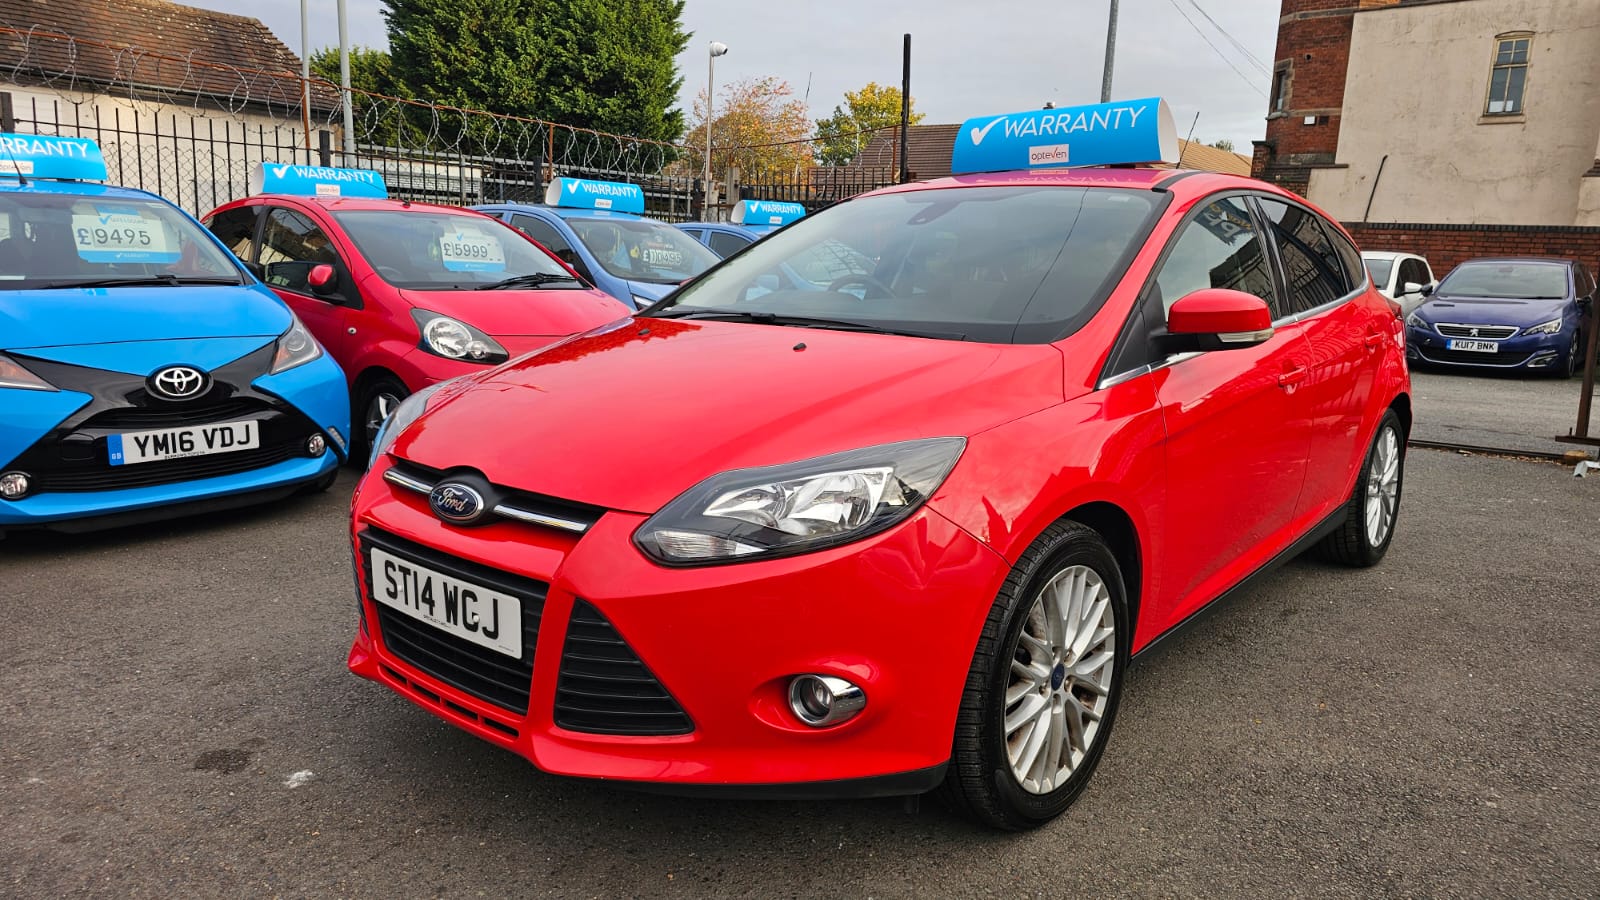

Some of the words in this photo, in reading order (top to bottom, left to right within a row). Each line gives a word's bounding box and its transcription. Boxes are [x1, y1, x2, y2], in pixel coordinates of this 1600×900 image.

[1004, 105, 1147, 138] WARRANTY
[0, 137, 88, 157] RRANTY
[1031, 147, 1067, 161] opteven
[293, 166, 374, 183] WARRANTY
[581, 182, 638, 198] WARRANTY
[760, 202, 801, 215] WARRANTY
[77, 228, 151, 246] £9495
[443, 242, 488, 258] £5999
[1455, 340, 1475, 349] KU17
[1477, 342, 1495, 350] BNK
[134, 430, 195, 458] YM16
[202, 424, 251, 450] VDJ
[438, 488, 468, 512] Ford
[385, 560, 436, 616] ST14
[443, 581, 499, 640] WCJ
